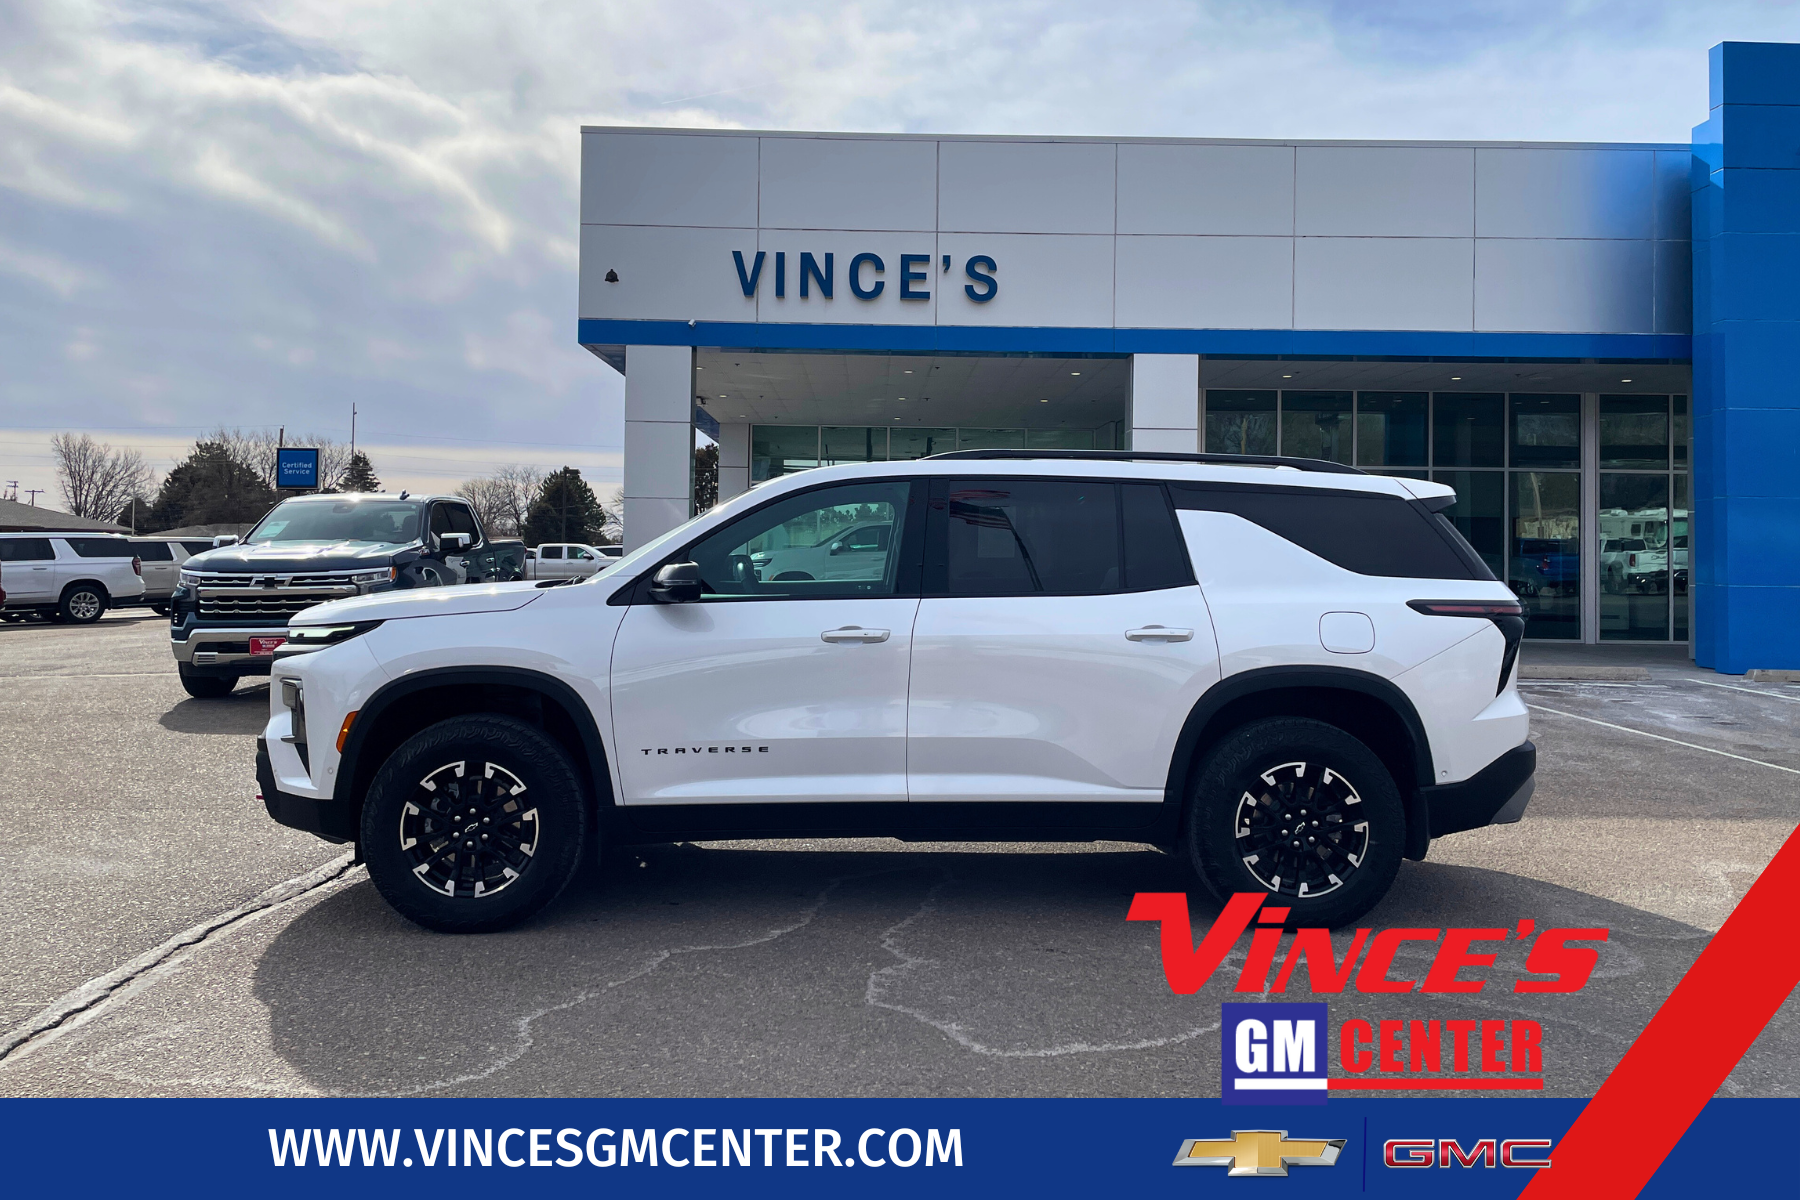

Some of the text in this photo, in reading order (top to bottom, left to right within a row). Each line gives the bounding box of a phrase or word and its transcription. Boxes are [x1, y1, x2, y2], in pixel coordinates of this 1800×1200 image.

[732, 251, 998, 304] VINCE'S
[281, 461, 313, 469] Certified
[640, 746, 770, 756] TRAVERSE
